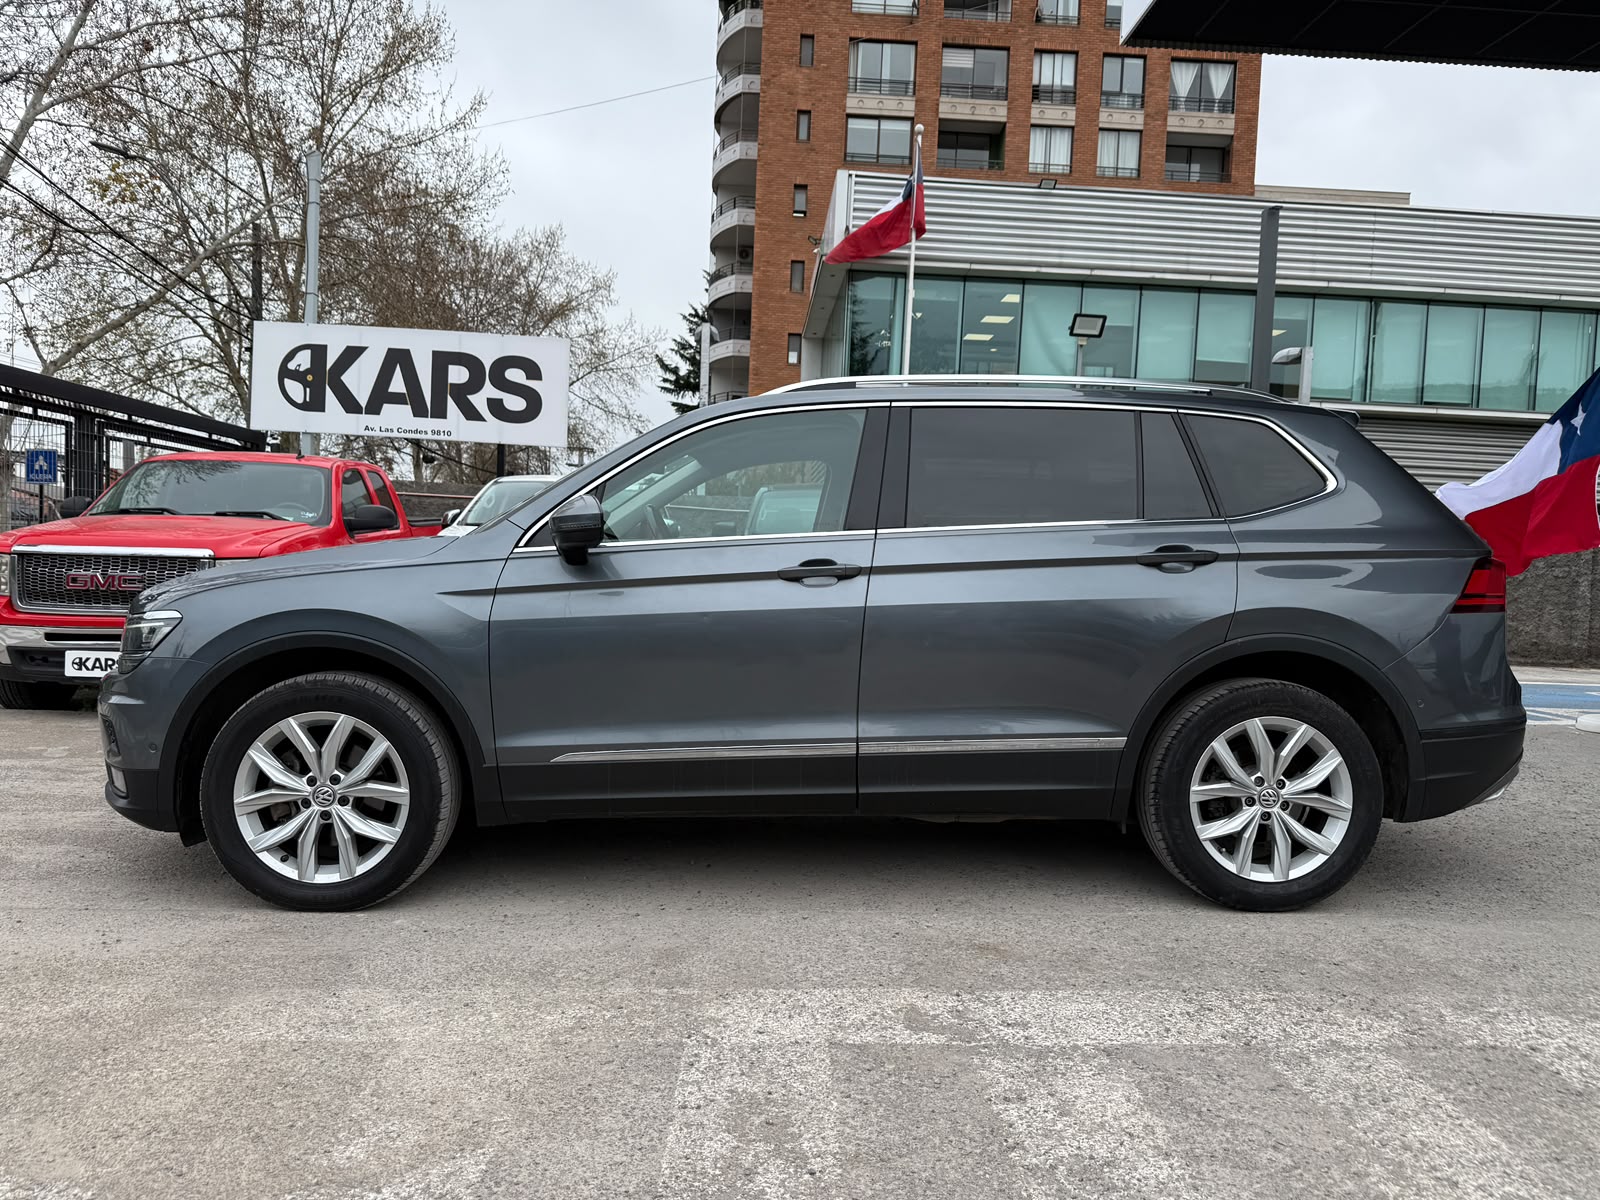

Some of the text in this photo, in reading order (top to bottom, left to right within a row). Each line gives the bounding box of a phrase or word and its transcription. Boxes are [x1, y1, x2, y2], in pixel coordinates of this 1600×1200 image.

[278, 343, 543, 424] KARS
[363, 425, 452, 437] Av. Las Condes 9810
[65, 572, 144, 591] GMC
[72, 656, 119, 671] KAR
